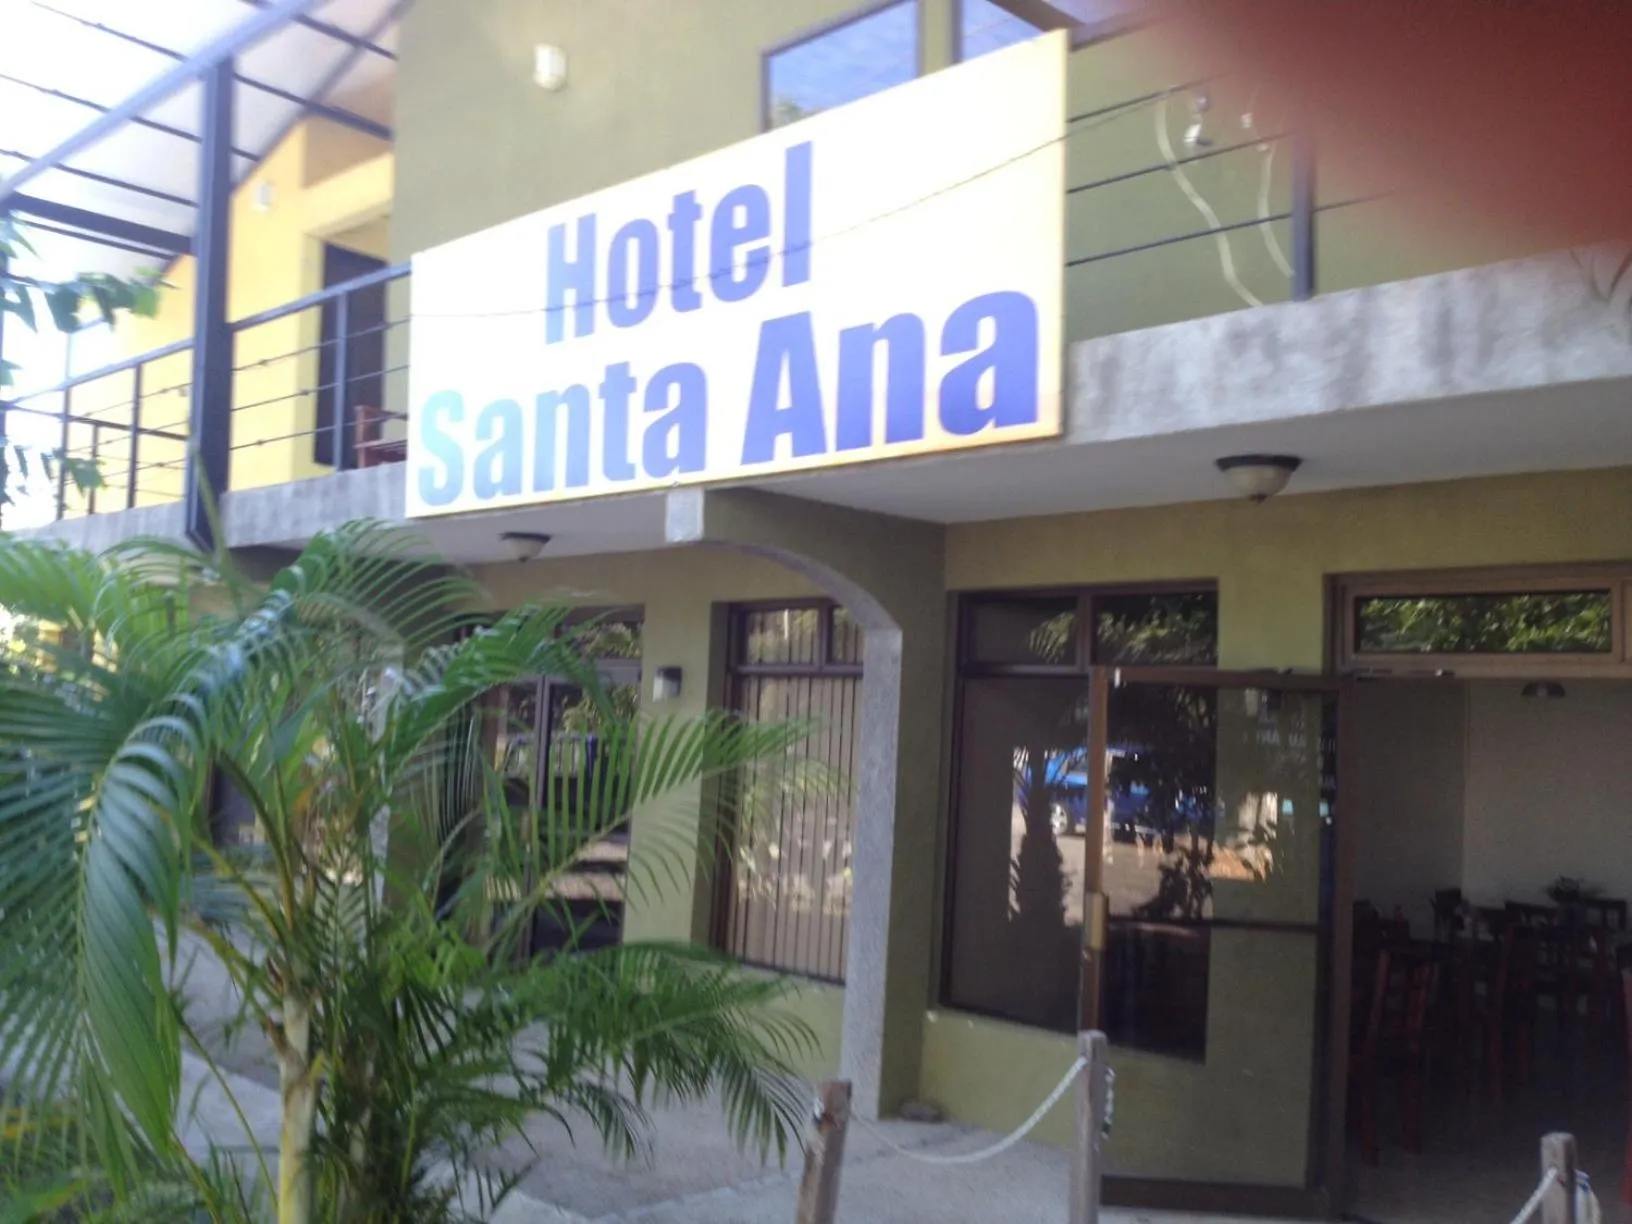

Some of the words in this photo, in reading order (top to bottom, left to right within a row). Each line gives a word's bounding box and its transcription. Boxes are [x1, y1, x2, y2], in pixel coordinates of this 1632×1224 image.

[545, 141, 813, 345] Hotel
[417, 361, 707, 507] Santa
[740, 290, 1039, 466] Ana
